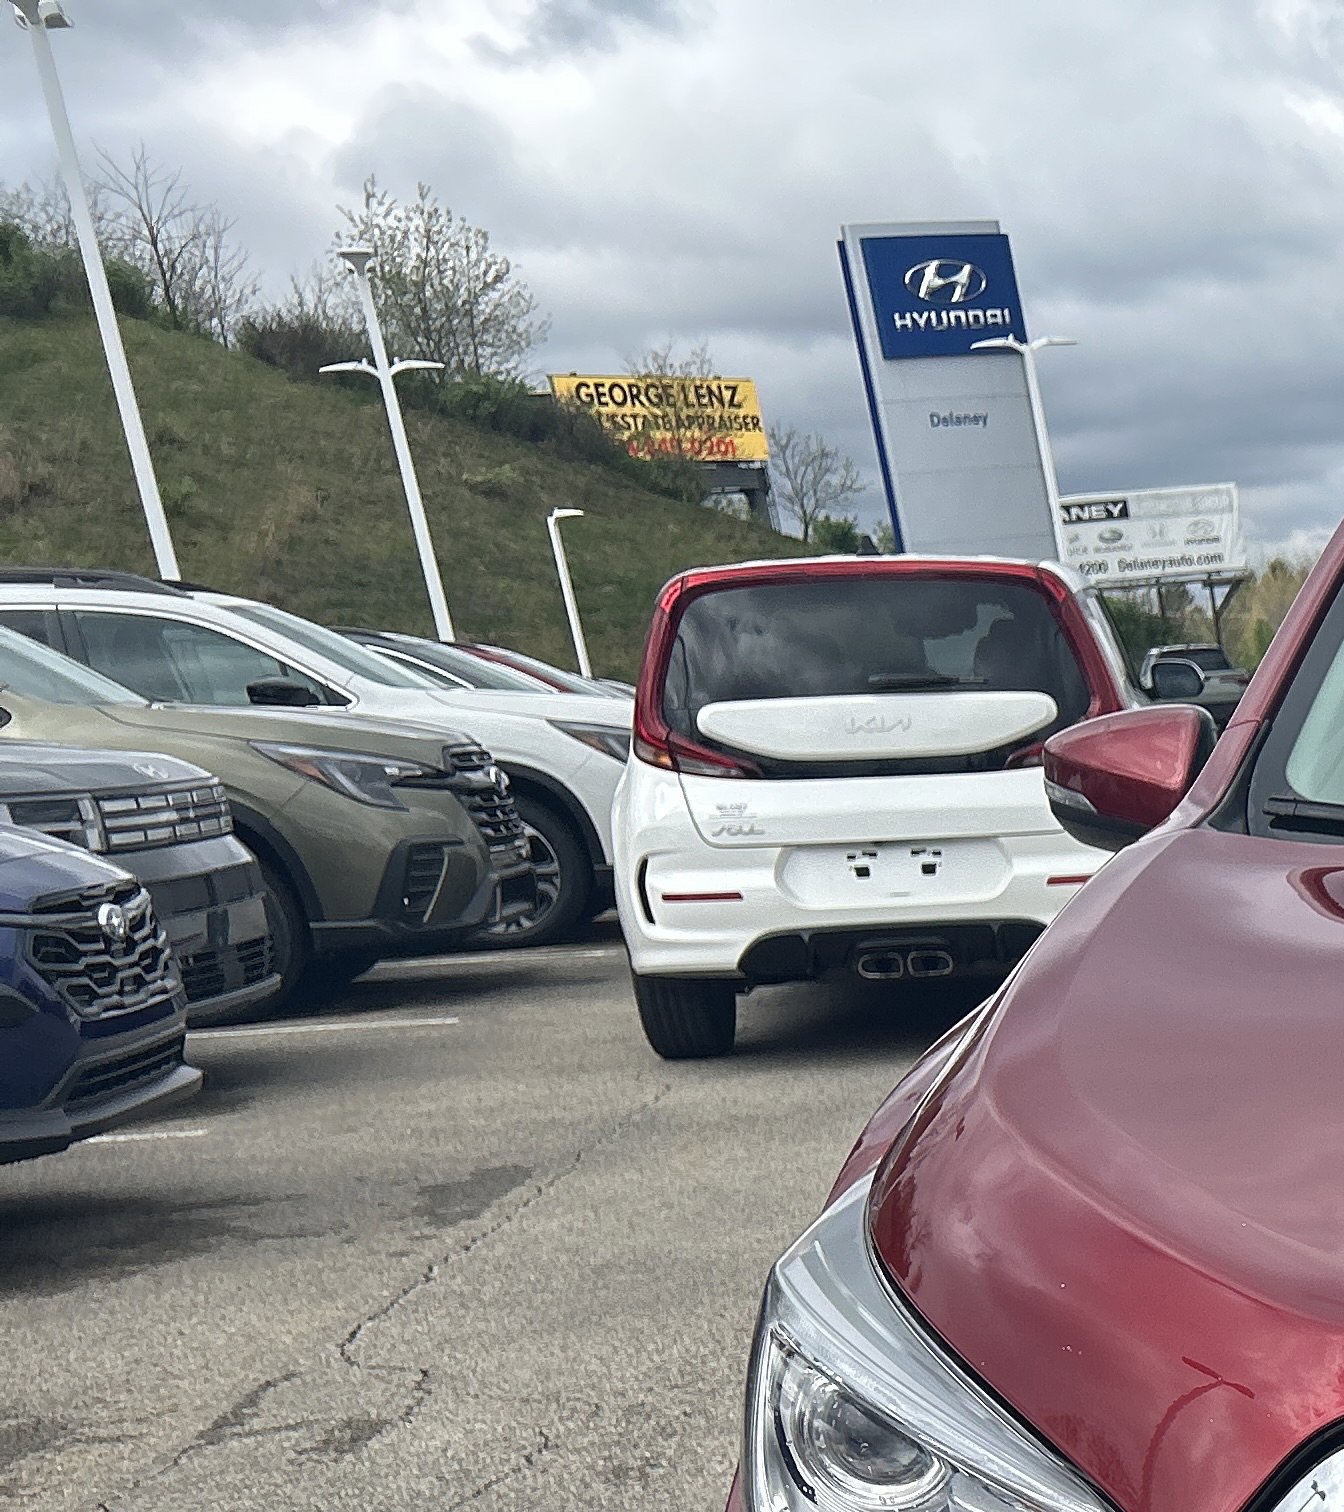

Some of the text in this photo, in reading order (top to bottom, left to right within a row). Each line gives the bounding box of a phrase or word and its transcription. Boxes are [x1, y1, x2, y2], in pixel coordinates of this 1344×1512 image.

[894, 307, 1012, 333] HYUNDAI
[575, 381, 743, 409] GEORGE LENZ
[929, 411, 988, 430] Delaney
[1060, 501, 1123, 523] ANEY
